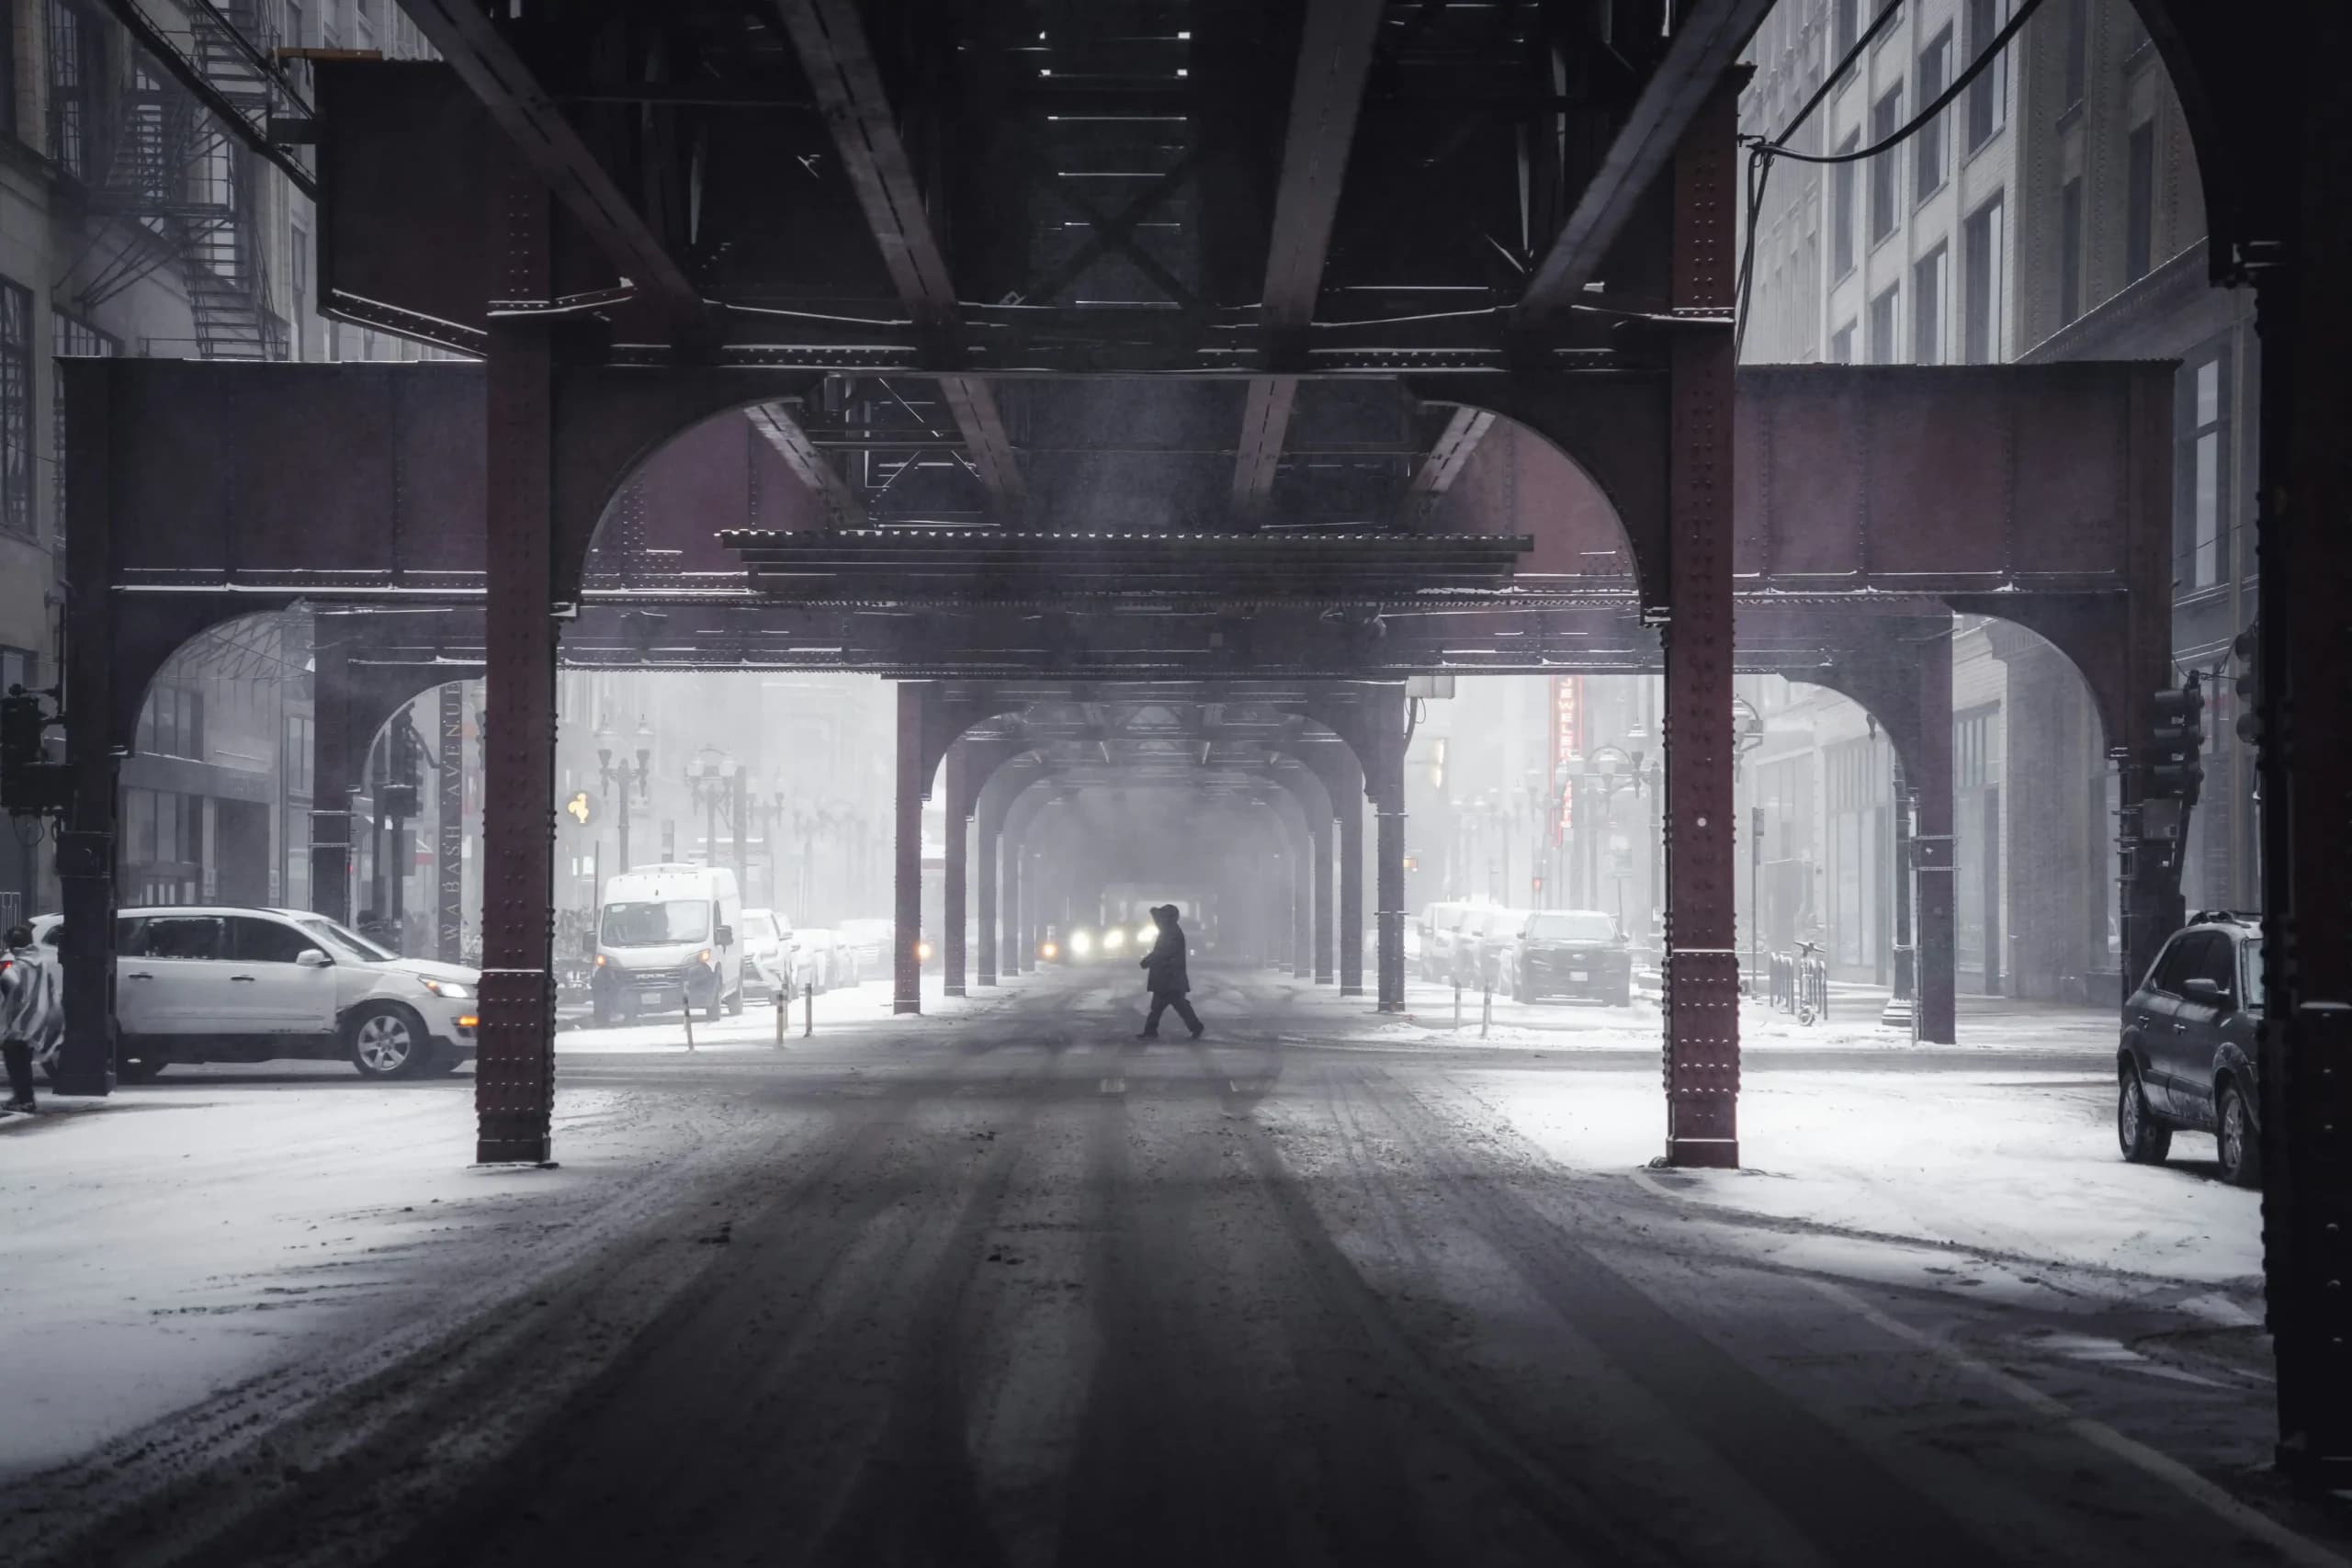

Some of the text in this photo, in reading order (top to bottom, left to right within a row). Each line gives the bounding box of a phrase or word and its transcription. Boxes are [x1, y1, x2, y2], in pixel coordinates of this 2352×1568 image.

[1559, 677, 1574, 763] JEWELER
[443, 682, 461, 942] WABASH AVENUE
